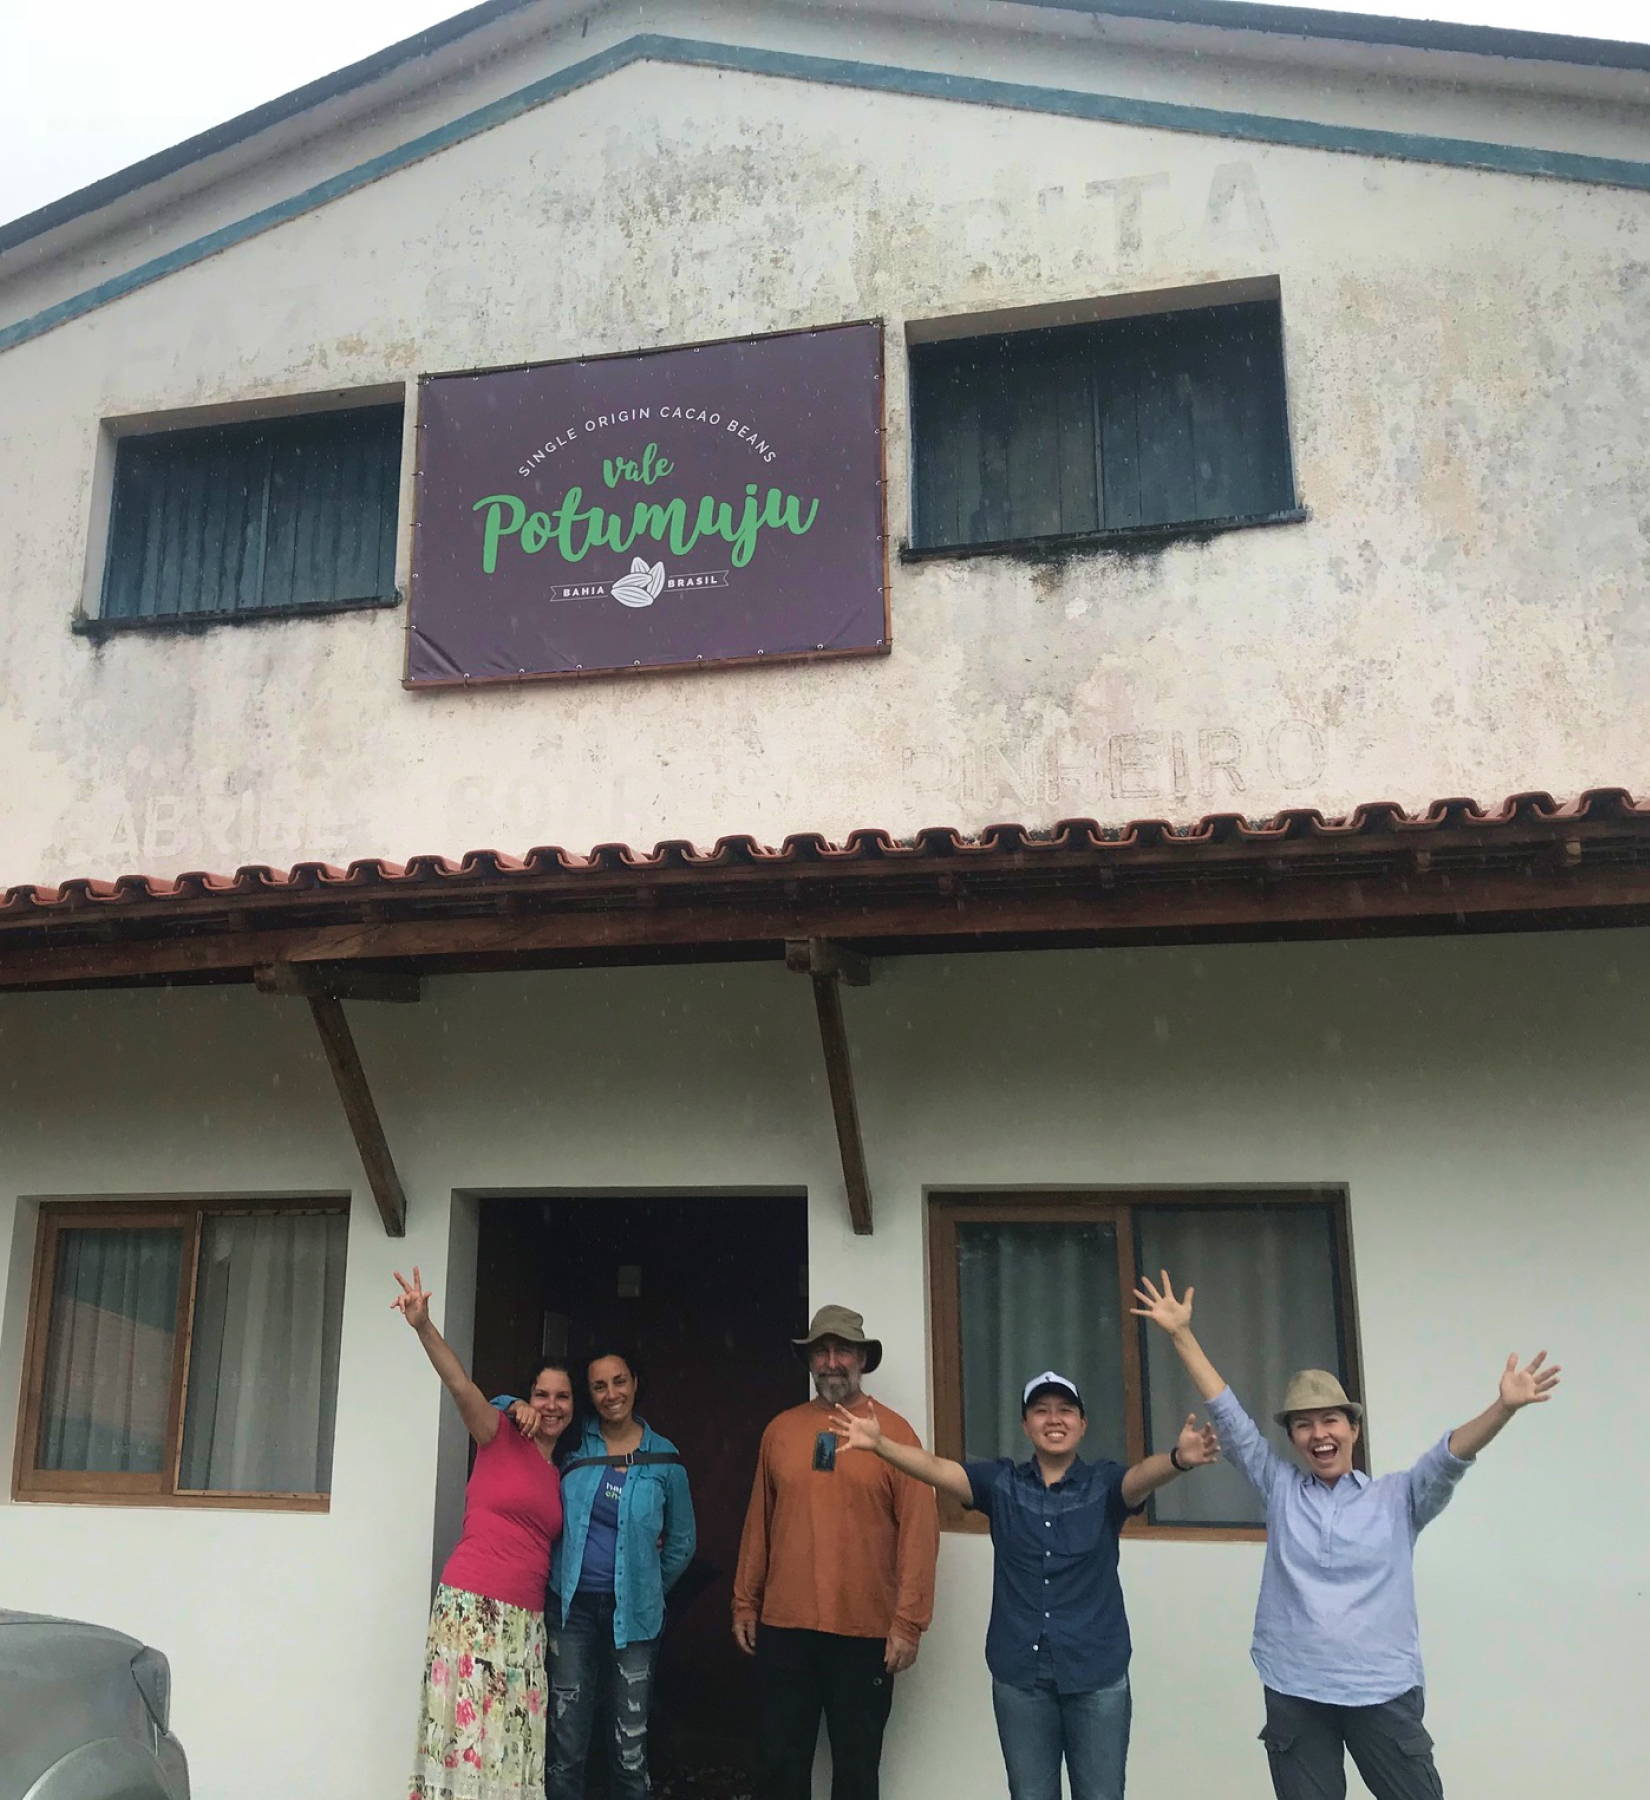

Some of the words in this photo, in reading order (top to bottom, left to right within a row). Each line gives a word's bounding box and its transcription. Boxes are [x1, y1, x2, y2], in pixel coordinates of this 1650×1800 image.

[517, 427, 578, 478] SINGLE
[584, 406, 650, 433] ORIGIN
[659, 405, 721, 425] CACAO
[726, 419, 777, 464] BEANS
[602, 442, 675, 488] vale
[472, 483, 820, 574] Potumuju
[562, 586, 605, 598] BAHIA
[667, 575, 718, 588] BRASIL
